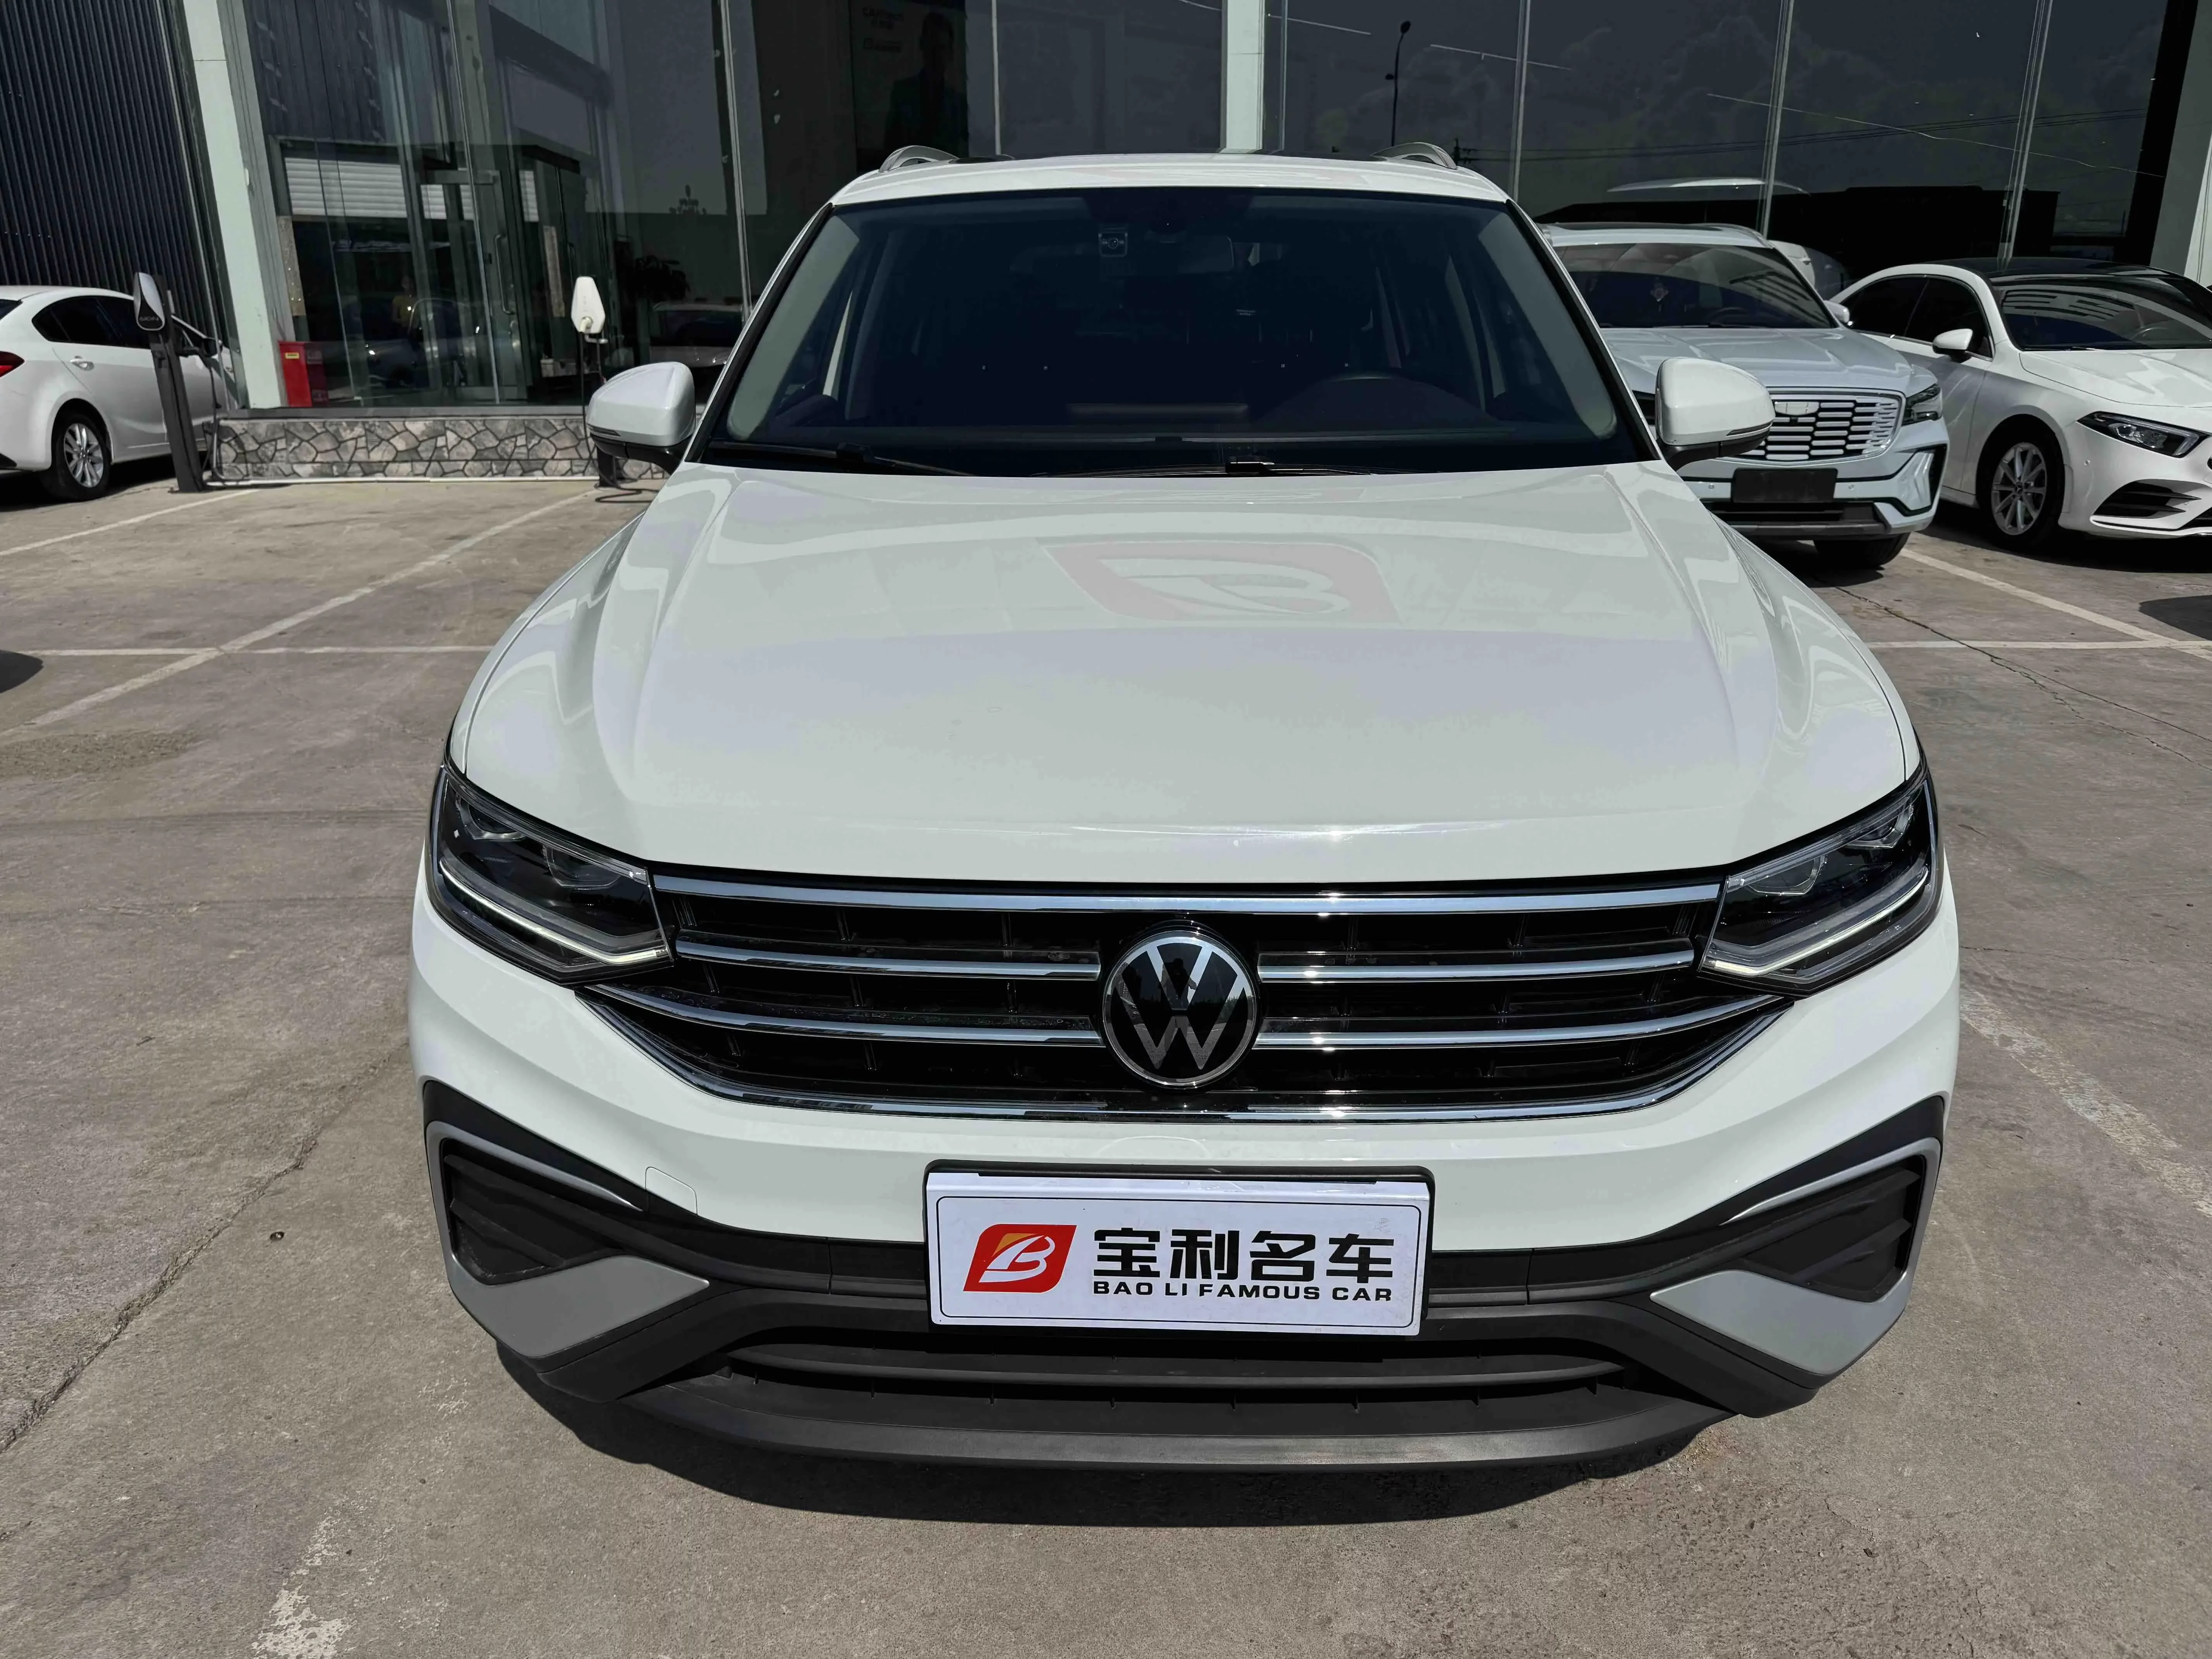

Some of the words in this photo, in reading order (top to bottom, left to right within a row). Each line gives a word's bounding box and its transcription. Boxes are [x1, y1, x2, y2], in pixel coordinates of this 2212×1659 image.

[1094, 1228, 1394, 1283] 宝利名车
[1094, 1281, 1153, 1295] BAO
[1165, 1283, 1187, 1296] LI
[1199, 1284, 1320, 1300] FAMOUS
[1332, 1287, 1391, 1301] CAR
